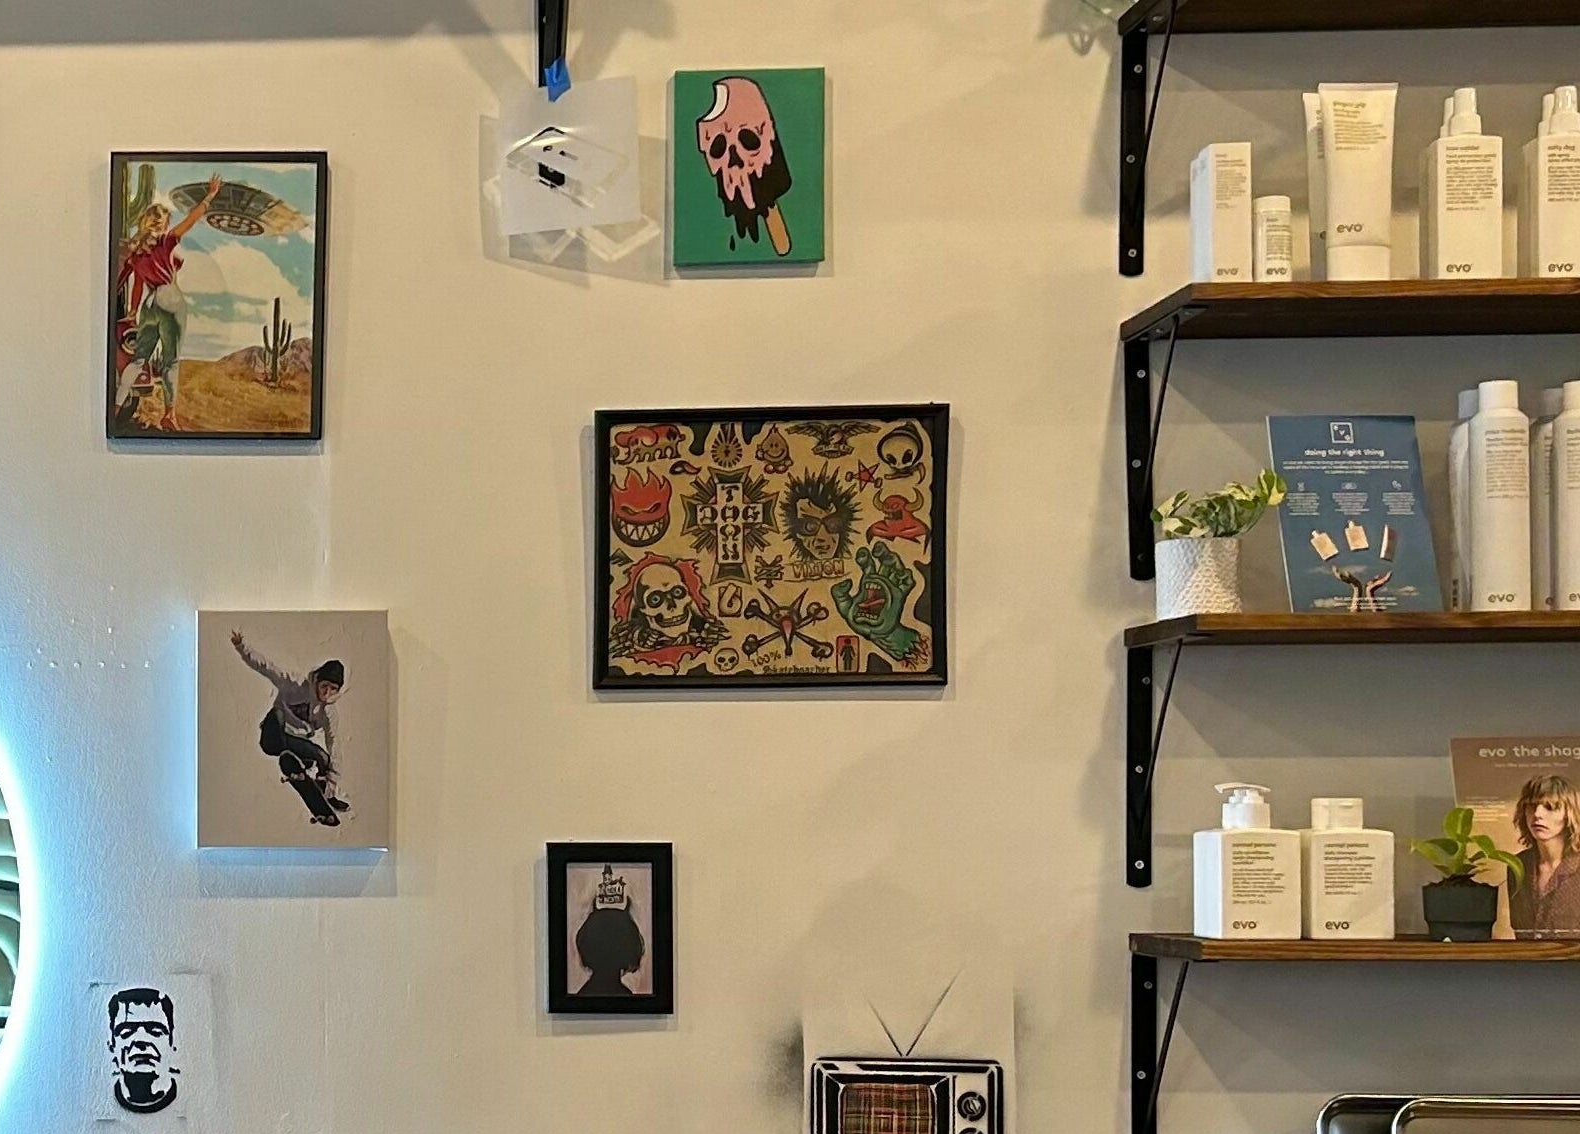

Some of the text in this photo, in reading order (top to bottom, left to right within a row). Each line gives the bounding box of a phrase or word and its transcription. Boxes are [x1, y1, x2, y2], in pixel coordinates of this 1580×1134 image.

[1336, 223, 1363, 233] evo
[1217, 268, 1239, 276] evo
[1446, 264, 1471, 273] evo
[1548, 263, 1573, 272] evo
[1487, 594, 1515, 603] evo
[1569, 592, 1580, 602] ev
[1478, 747, 1506, 758] evo
[1513, 745, 1540, 757] the
[1232, 920, 1257, 929] evo
[1325, 921, 1350, 930] evo
